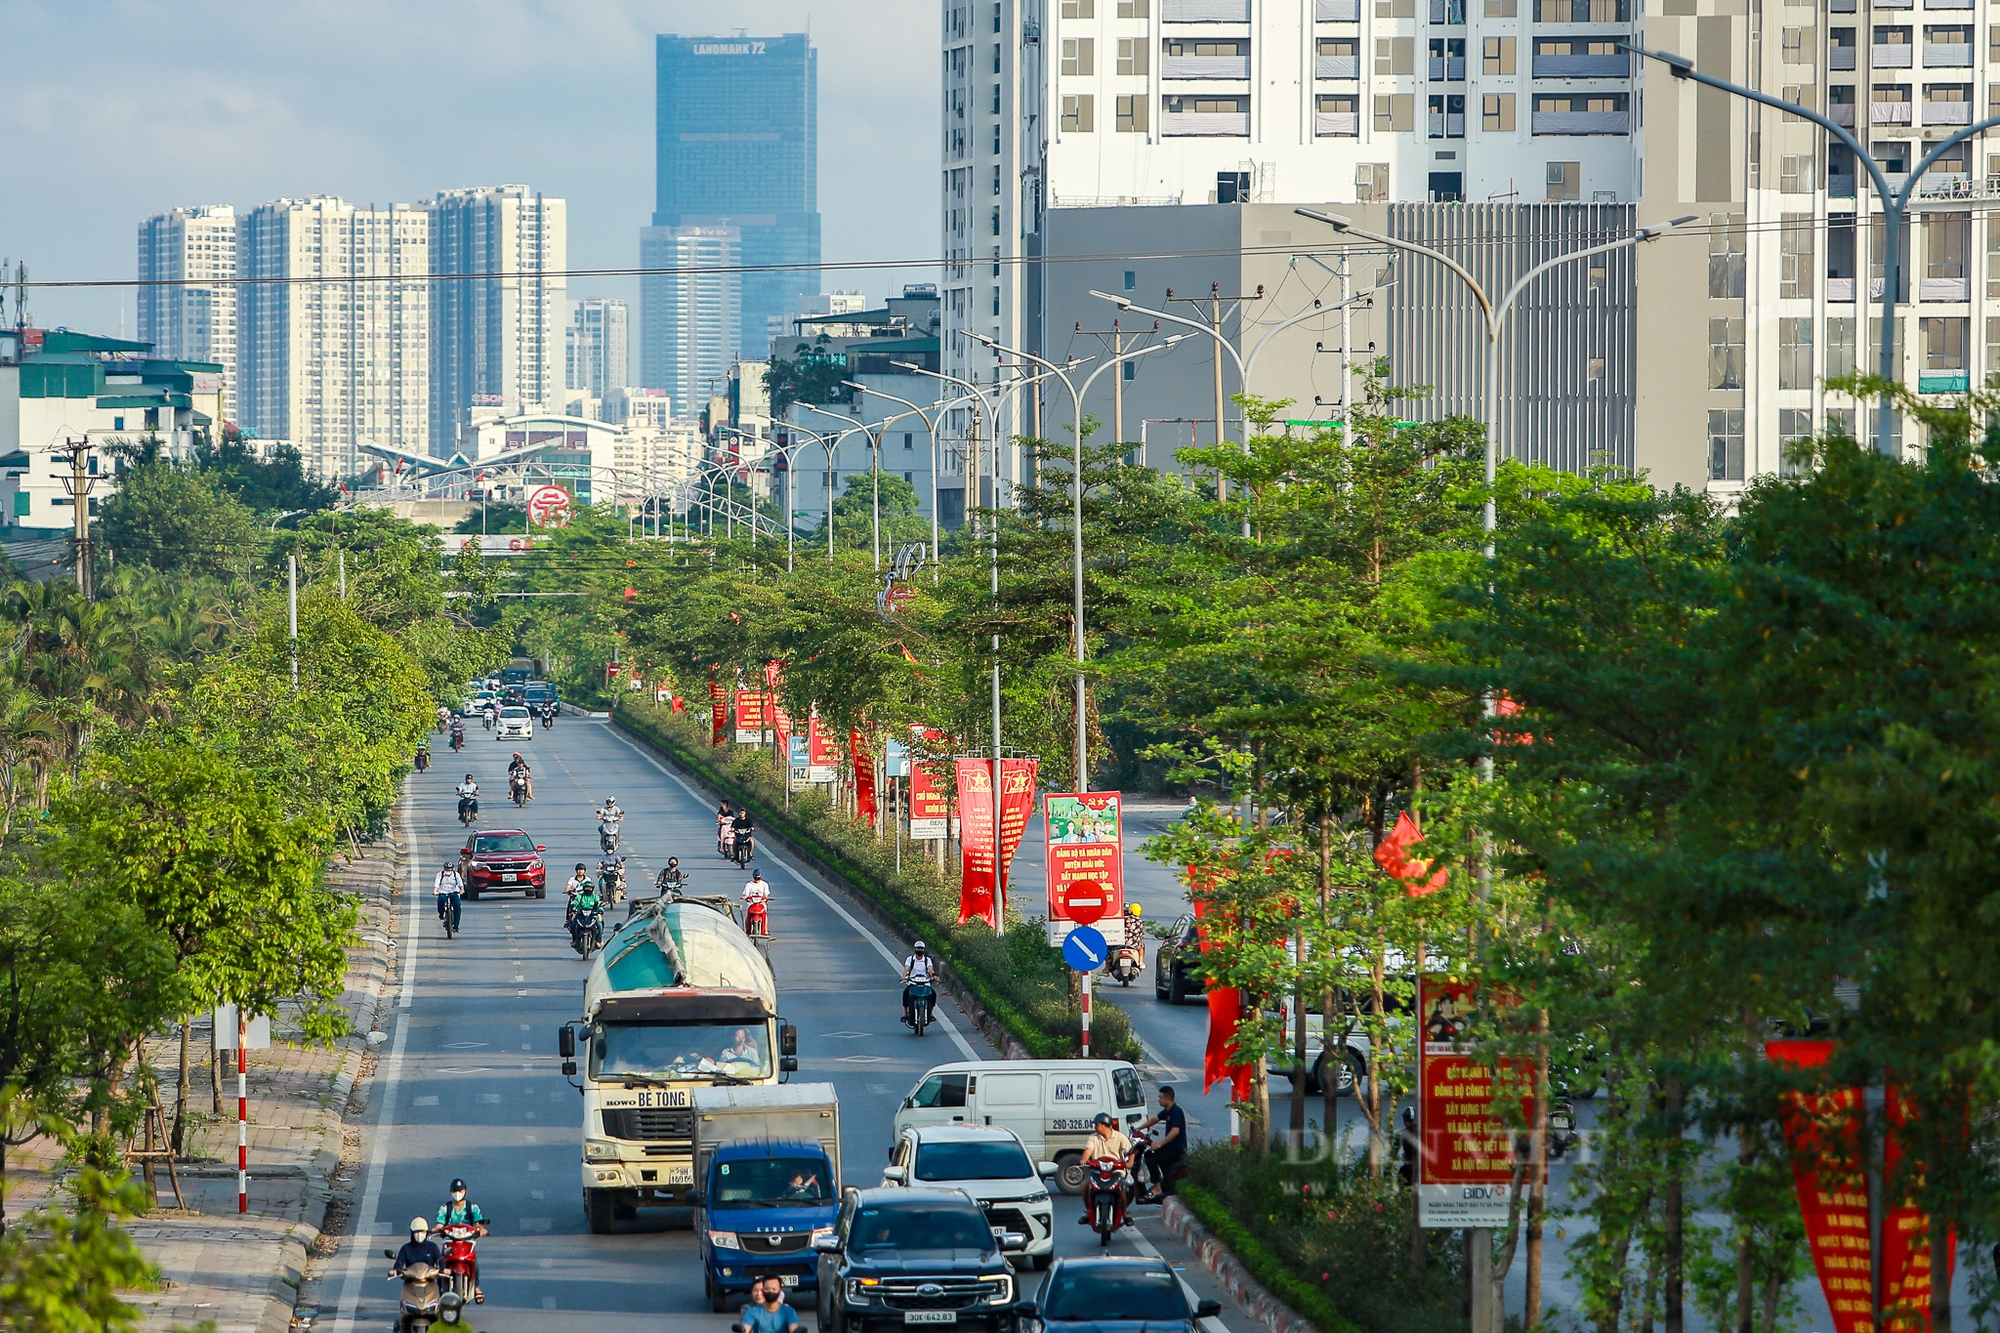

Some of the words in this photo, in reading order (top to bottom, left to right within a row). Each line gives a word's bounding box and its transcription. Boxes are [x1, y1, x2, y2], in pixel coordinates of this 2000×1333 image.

[694, 44, 749, 55] LANDMARK
[751, 42, 766, 54] 72
[1056, 848, 1071, 858] ĐẢNG
[1071, 848, 1079, 858] BỘ
[1079, 848, 1086, 857] VÀ
[1087, 848, 1101, 857] NHÂN
[1102, 847, 1113, 856] DÂN
[1064, 860, 1081, 870] HUYỆN
[1082, 859, 1094, 868] HOÀI
[1095, 859, 1105, 868] ĐỨC
[1072, 872, 1088, 881] MẠNH
[1088, 872, 1099, 881] HỌC
[1099, 870, 1109, 881] TẬP
[1056, 883, 1064, 892] VÀ
[638, 1088, 652, 1106] BÊ
[655, 1087, 685, 1106] TÔNG
[1055, 1081, 1074, 1100] KHÓA
[1435, 1082, 1453, 1097] ĐỒNG
[1455, 1083, 1464, 1099] BỘ
[1466, 1082, 1484, 1097] CÔNG
[1446, 1102, 1459, 1115] XÂY
[1460, 1103, 1479, 1117] DỰNG
[1053, 1119, 1095, 1129] 29D-326.04
[1448, 1119, 1456, 1133] VÀ
[1458, 1118, 1472, 1134] BẢO
[1473, 1119, 1482, 1135] VỆ
[1454, 1137, 1462, 1152] TỔ
[1464, 1138, 1482, 1153] QUỐC
[1483, 1138, 1498, 1154] VIỆT
[1452, 1156, 1461, 1170] XÃ
[1463, 1157, 1475, 1172] HỘI
[1476, 1156, 1490, 1170] CHỦ
[1463, 1187, 1494, 1200] BIDV
